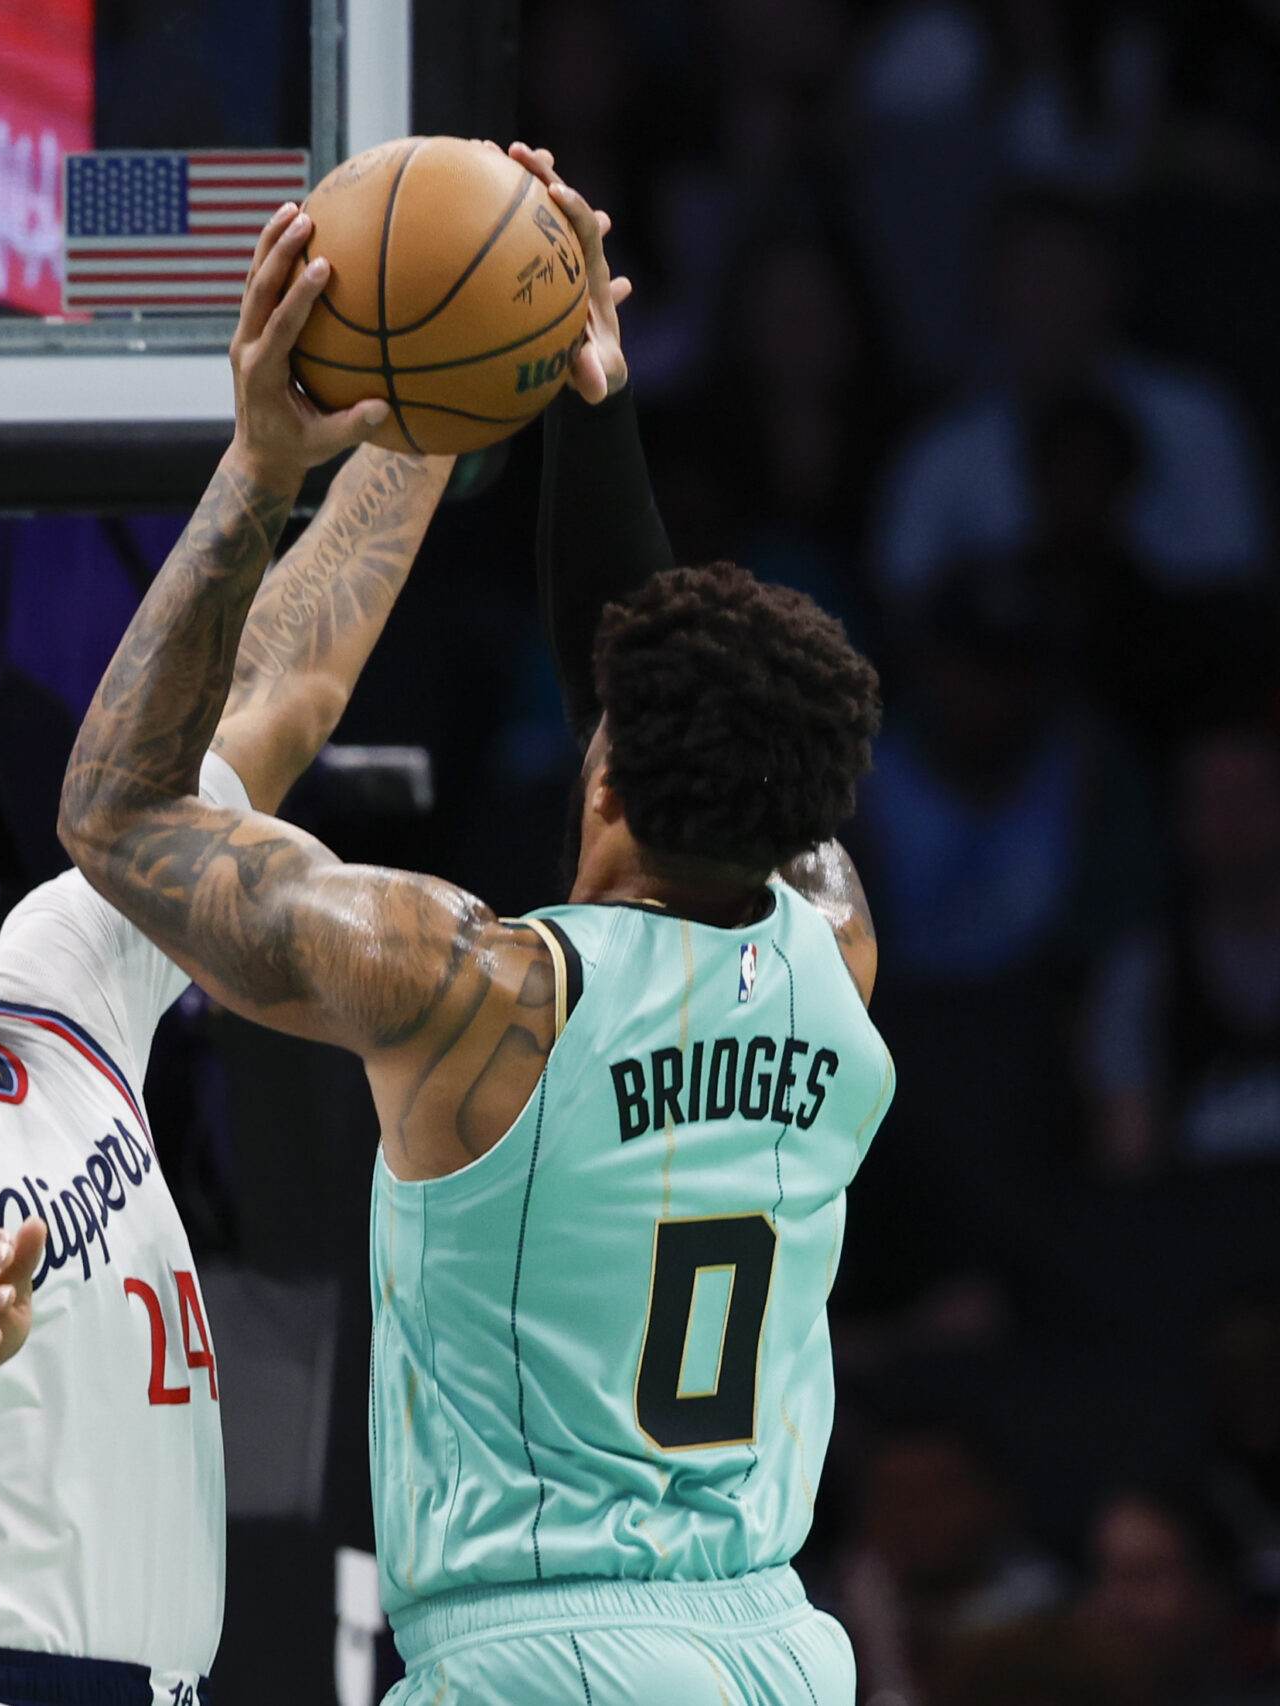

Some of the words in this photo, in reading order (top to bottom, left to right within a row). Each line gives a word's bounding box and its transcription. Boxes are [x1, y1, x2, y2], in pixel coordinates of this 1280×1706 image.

[609, 1035, 839, 1143] BRIDGES
[123, 1270, 218, 1406] 24
[633, 1210, 779, 1453] 0
